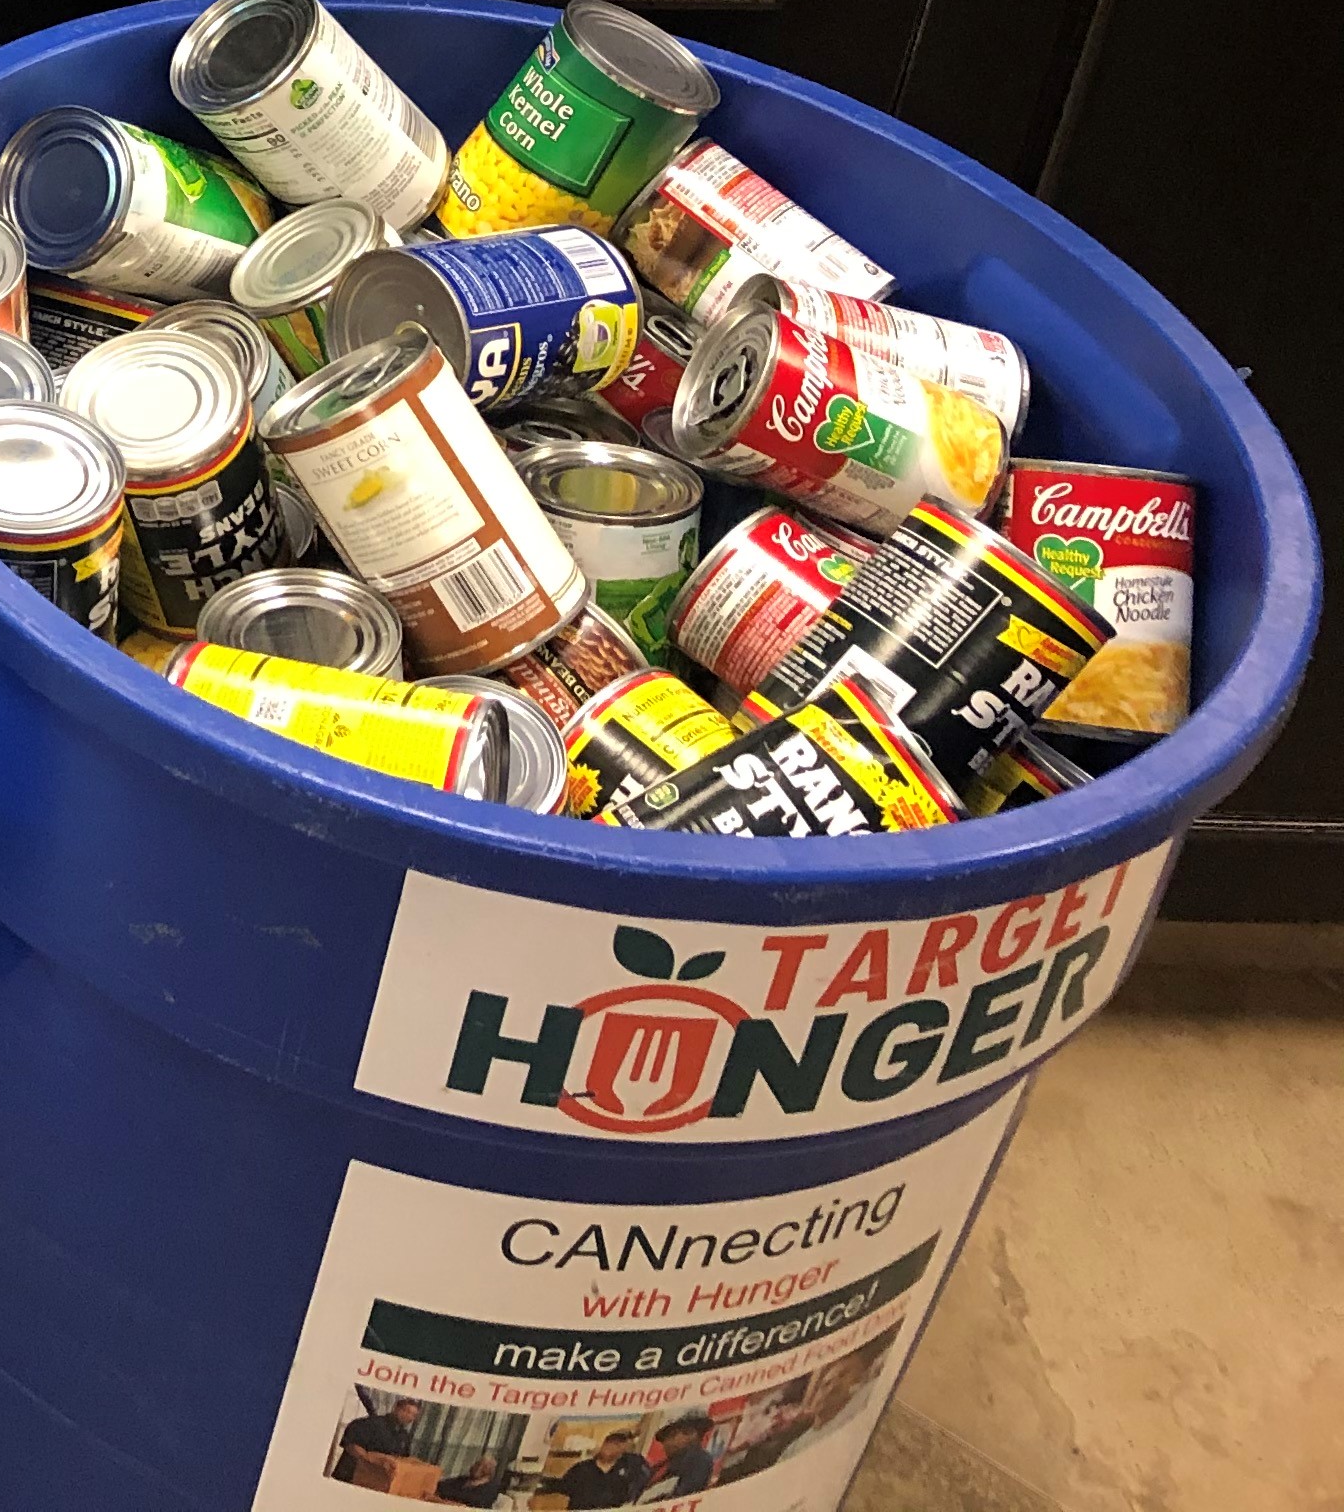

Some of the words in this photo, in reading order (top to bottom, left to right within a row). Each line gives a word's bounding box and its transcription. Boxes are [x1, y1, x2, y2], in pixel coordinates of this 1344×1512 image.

[506, 86, 565, 143] Kernel
[522, 65, 575, 124] Whole
[232, 110, 264, 127] Facts
[498, 109, 536, 152] Corn
[267, 133, 286, 148] 90
[824, 405, 854, 449] Healthy
[312, 455, 356, 481] SWEET
[1031, 482, 1191, 543] Campbell's
[1041, 545, 1091, 565] Healthy
[1050, 561, 1104, 580] Request
[1112, 589, 1175, 607] Chicken
[1114, 575, 1174, 592] Homestyle
[1114, 603, 1172, 624] Noodle
[758, 859, 1130, 1011] TARGET
[500, 1182, 907, 1274] CANnecting
[582, 1287, 671, 1320] with
[687, 1257, 839, 1317] Hunger
[494, 1338, 622, 1375] make
[634, 1348, 661, 1371] a
[676, 1281, 880, 1368] difference!
[357, 1357, 421, 1389] Join
[430, 1374, 475, 1401] the
[489, 1382, 578, 1412] Target
[588, 1382, 694, 1413] Hunger
[699, 1349, 799, 1402] Canned
[803, 1323, 860, 1365] Food
